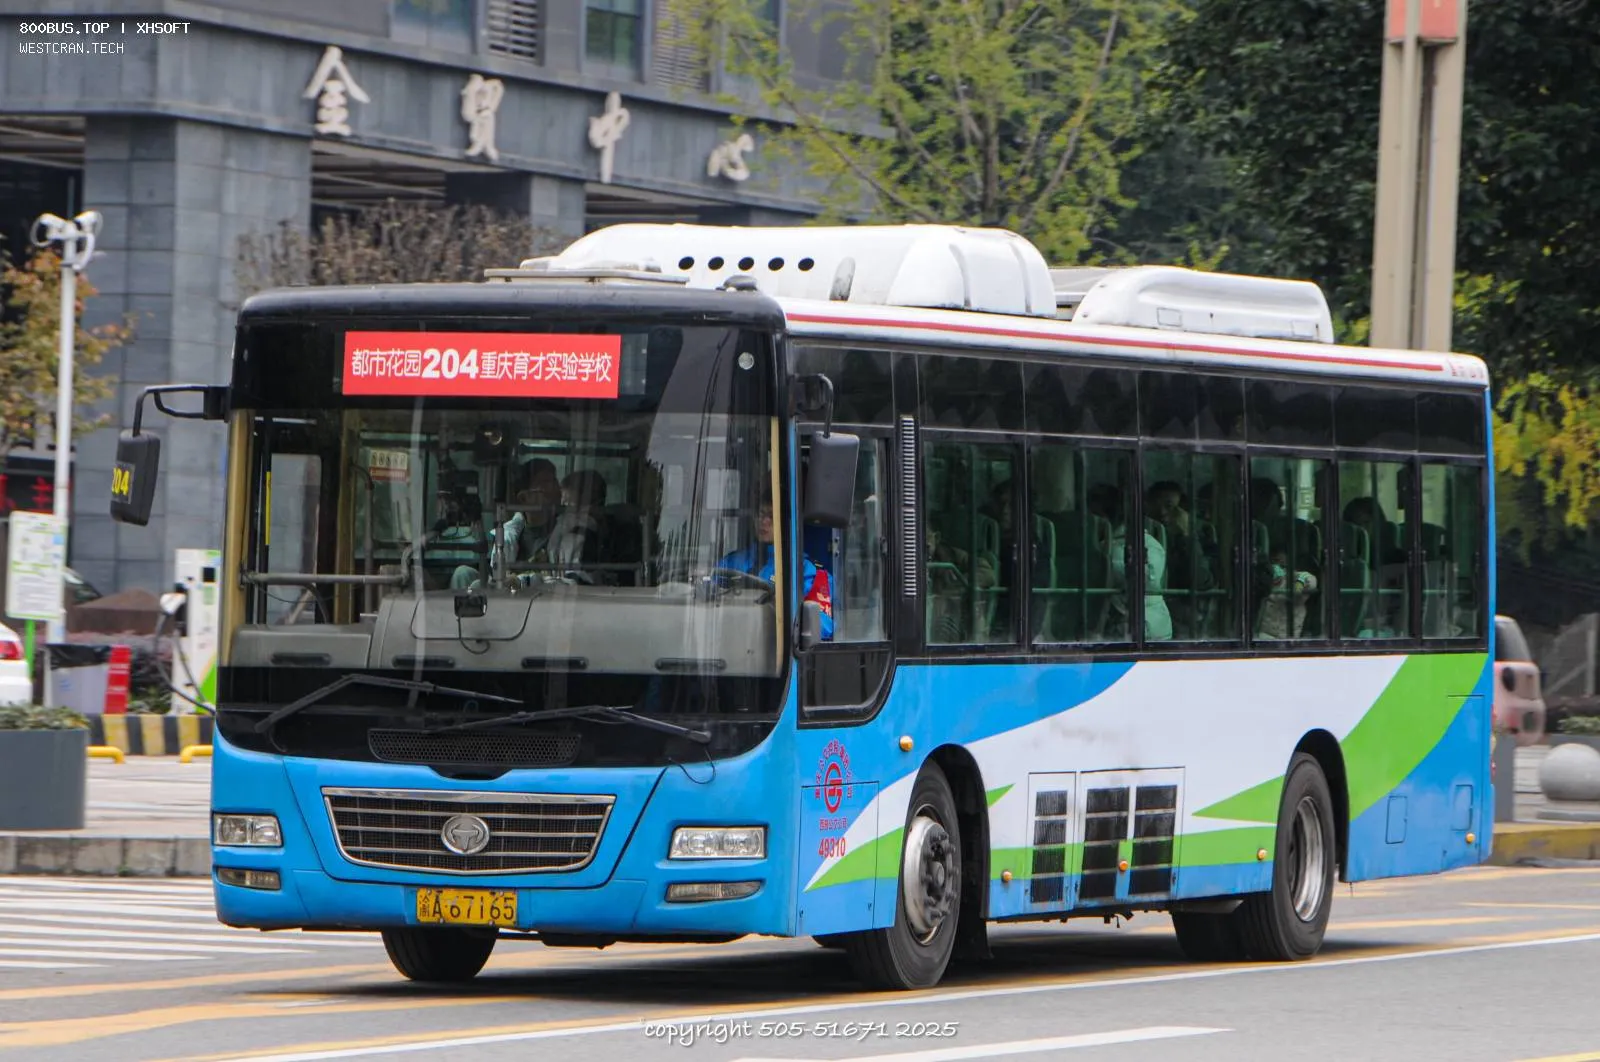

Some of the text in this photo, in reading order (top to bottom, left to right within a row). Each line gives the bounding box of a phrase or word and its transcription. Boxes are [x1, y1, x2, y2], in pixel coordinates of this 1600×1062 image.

[351, 348, 612, 383] 都市花园 204 重庆育才实验学校
[818, 837, 846, 859] 49310
